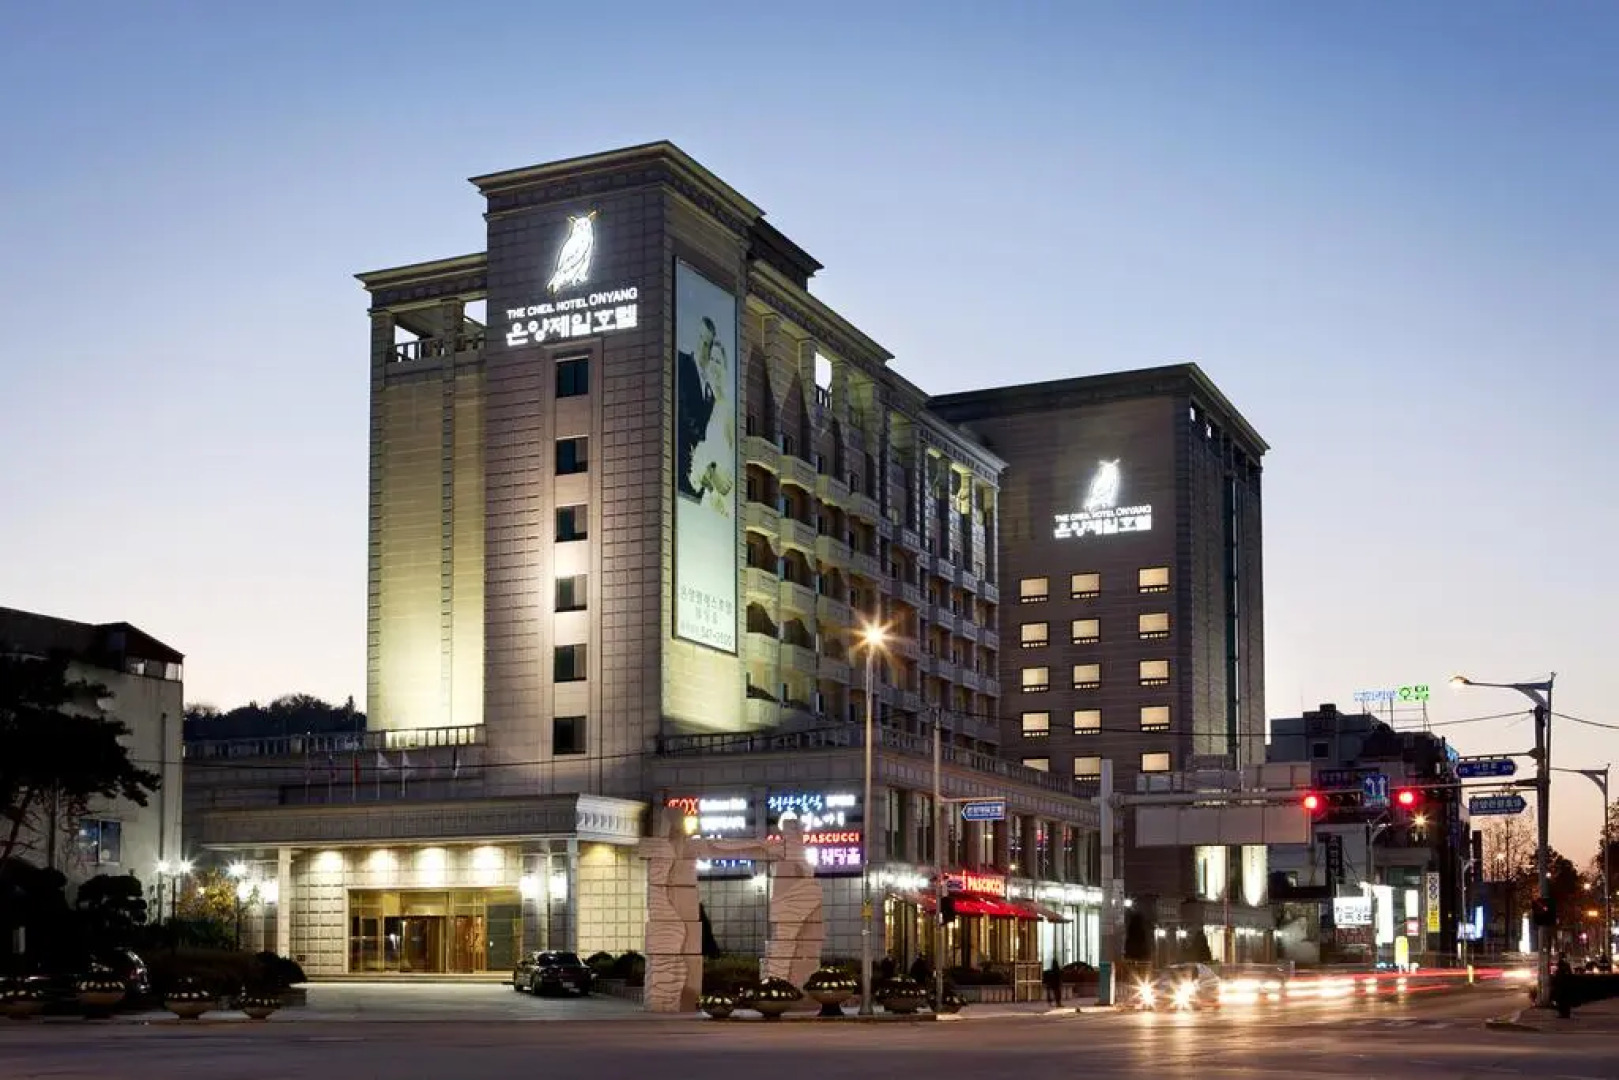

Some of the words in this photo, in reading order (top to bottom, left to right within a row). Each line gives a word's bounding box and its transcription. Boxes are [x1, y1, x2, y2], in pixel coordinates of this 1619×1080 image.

[507, 307, 526, 319] THE
[527, 303, 555, 316] CHEIL
[556, 298, 588, 311] HOTEL
[589, 287, 638, 305] ONYANG
[802, 832, 860, 844] PASCUCCI
